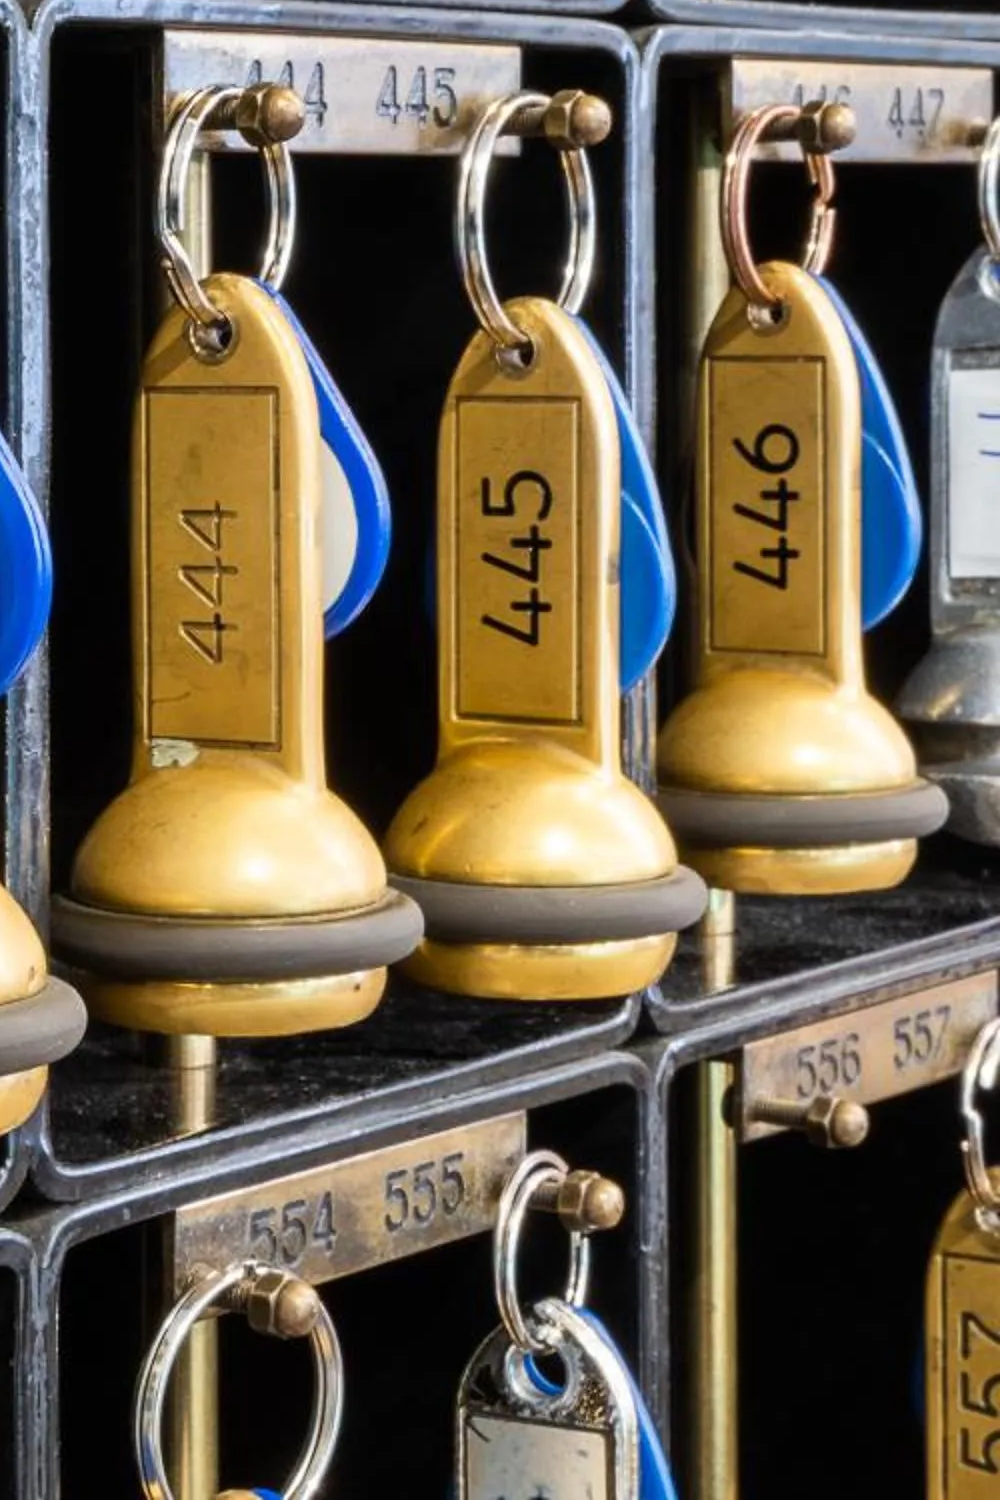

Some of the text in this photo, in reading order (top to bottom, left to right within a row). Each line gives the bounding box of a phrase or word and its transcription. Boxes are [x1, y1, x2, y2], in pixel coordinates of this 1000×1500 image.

[375, 64, 457, 129] 445
[888, 87, 945, 139] 447
[481, 469, 554, 647] 445
[732, 423, 800, 590] 446
[178, 500, 239, 664] 444
[796, 1005, 951, 1099] 556 557
[250, 1153, 465, 1266] 554 555
